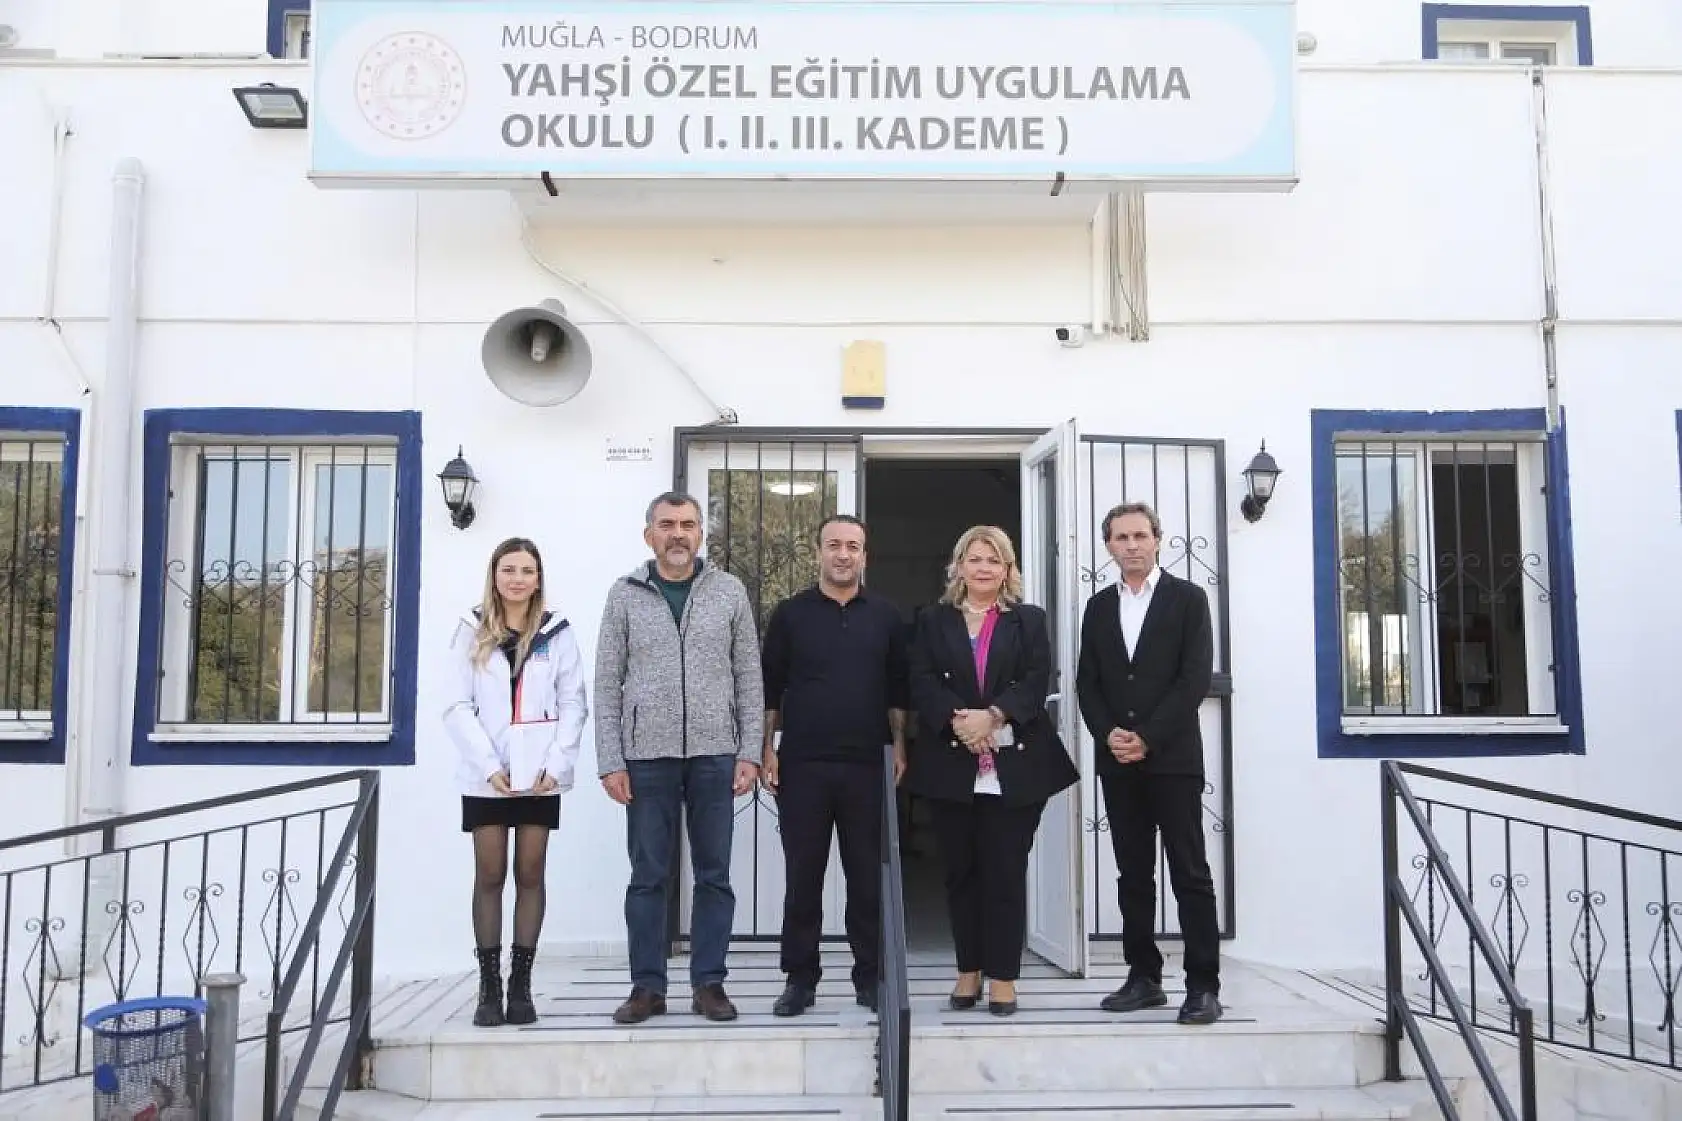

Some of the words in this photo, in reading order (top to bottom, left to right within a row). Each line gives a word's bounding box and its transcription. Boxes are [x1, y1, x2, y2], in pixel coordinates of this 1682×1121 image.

[501, 20, 605, 48] MUĞLA
[632, 25, 758, 50] BODRUM
[502, 55, 630, 107] YAHŞİ
[643, 56, 758, 98] ÖZEL
[770, 57, 921, 99] EĞİTİM
[936, 66, 1191, 100] UYGULAMA
[501, 113, 655, 148] OKULU
[857, 116, 1045, 150] KADEME
